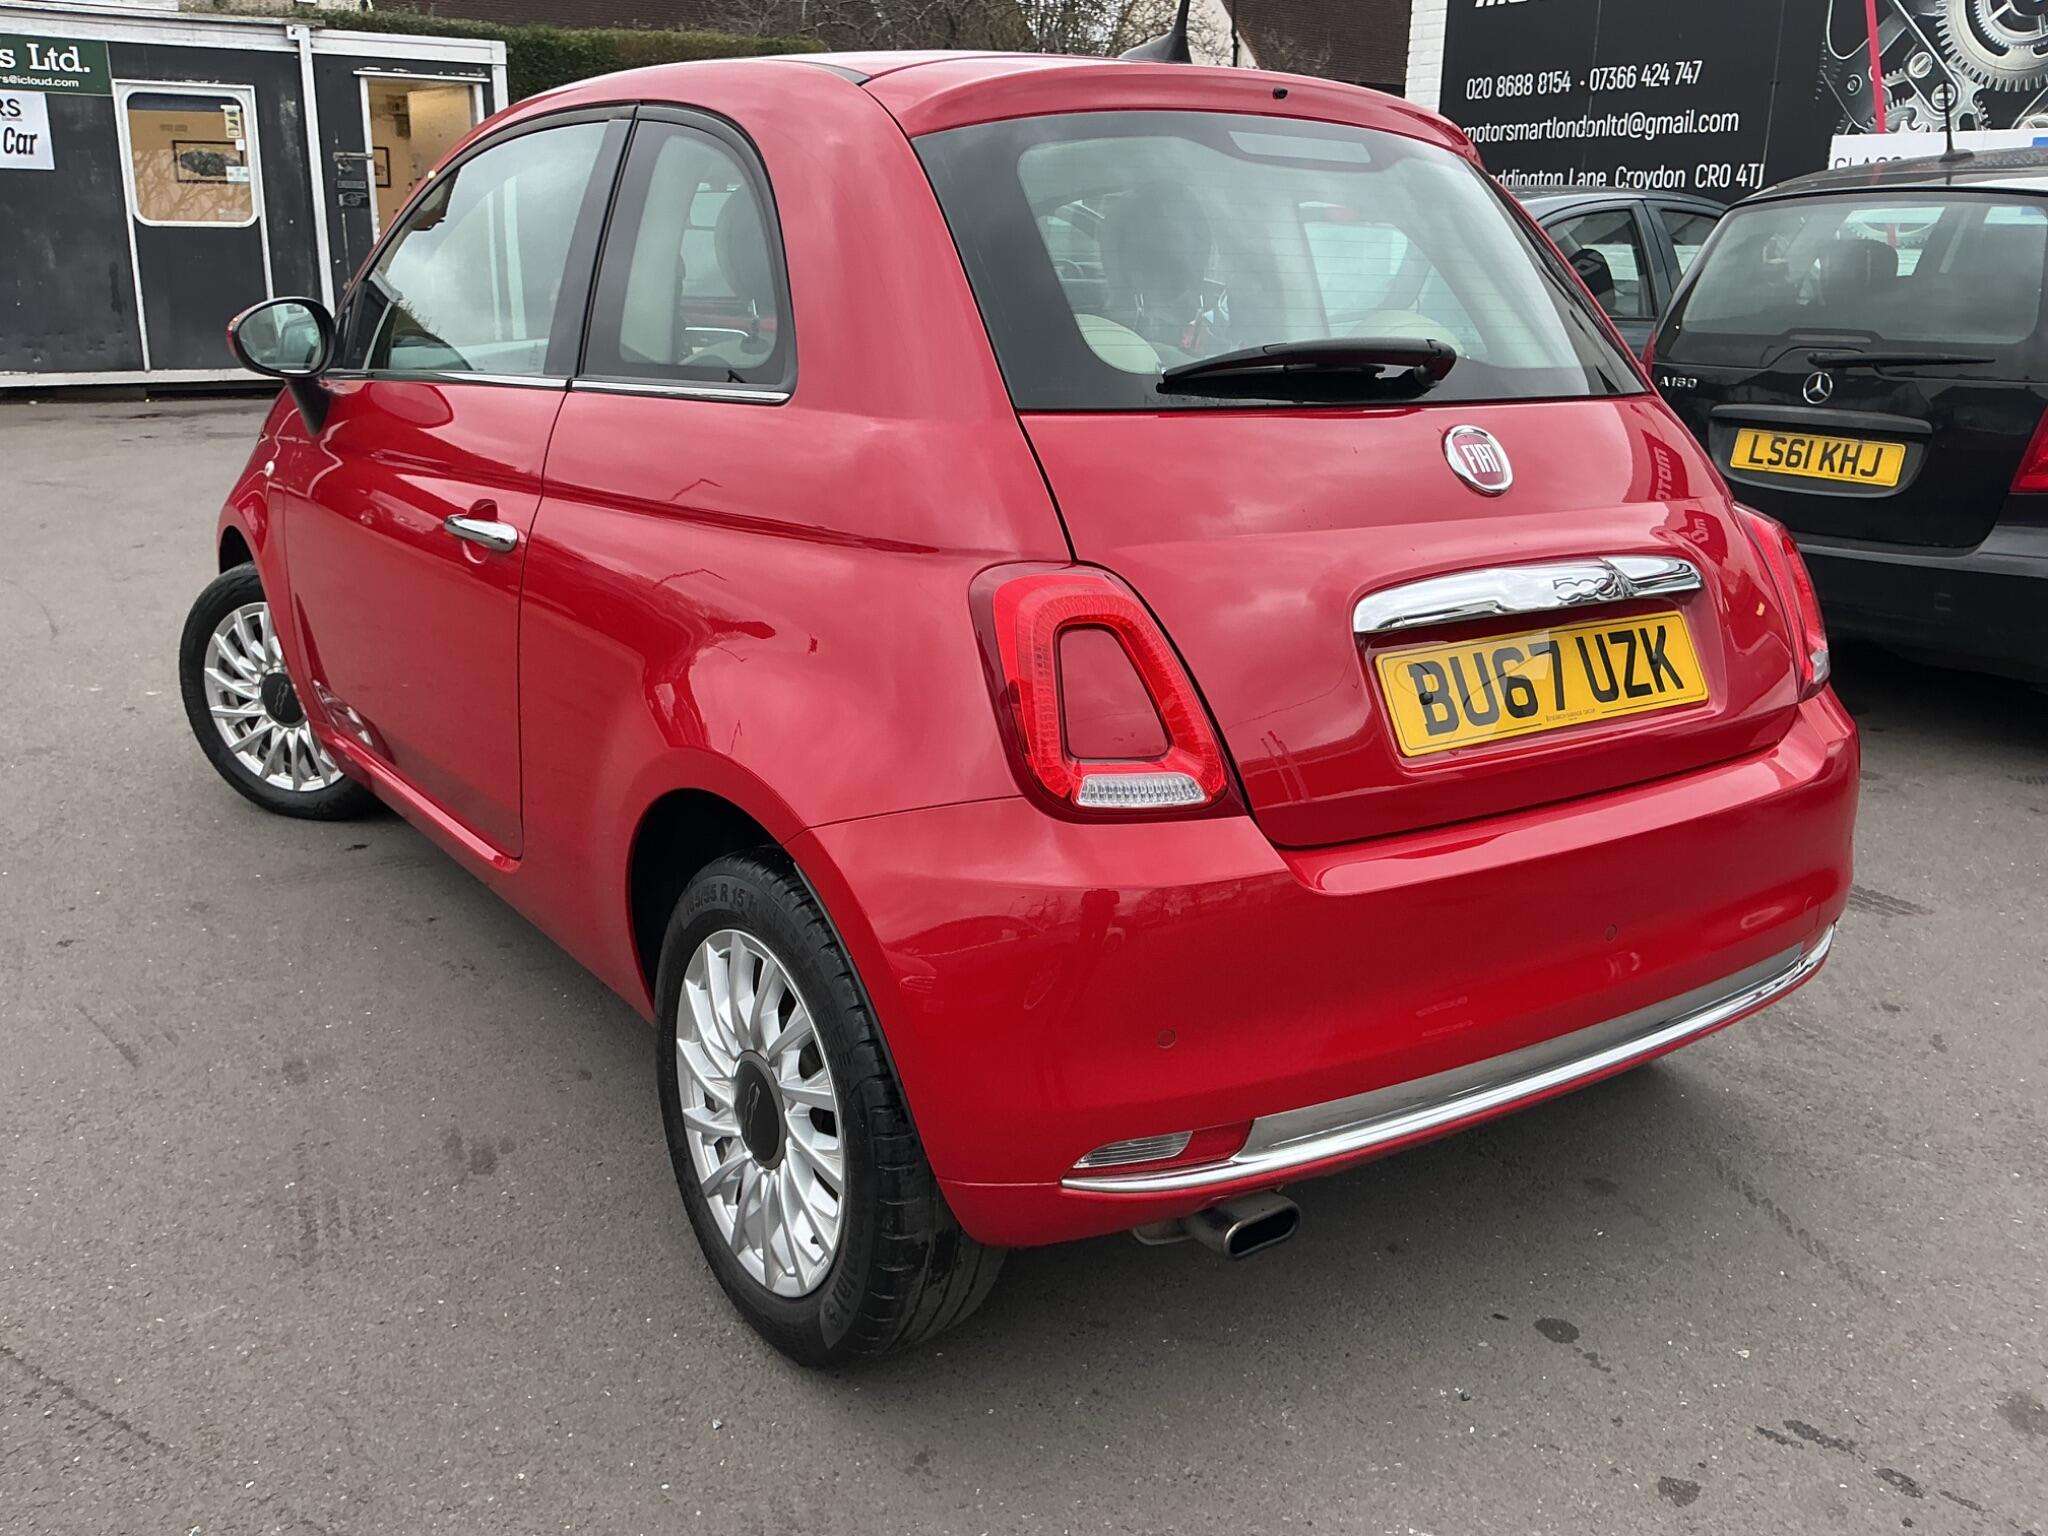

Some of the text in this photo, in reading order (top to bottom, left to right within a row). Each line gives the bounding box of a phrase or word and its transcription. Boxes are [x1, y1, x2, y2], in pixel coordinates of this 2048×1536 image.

[26, 43, 91, 73] Ltd.
[1466, 60, 1703, 100] 020 8688 8154 07366 424 747
[3, 126, 39, 155] Car
[1568, 167, 1607, 187] Lane
[1614, 164, 1686, 190] Croydon
[1735, 163, 1765, 190] 4TJ
[1460, 442, 1502, 474] FIAT
[1748, 434, 1883, 477] LS61 KHJ
[1552, 576, 1617, 602] 500
[1407, 624, 1685, 736] BU67 UZK
